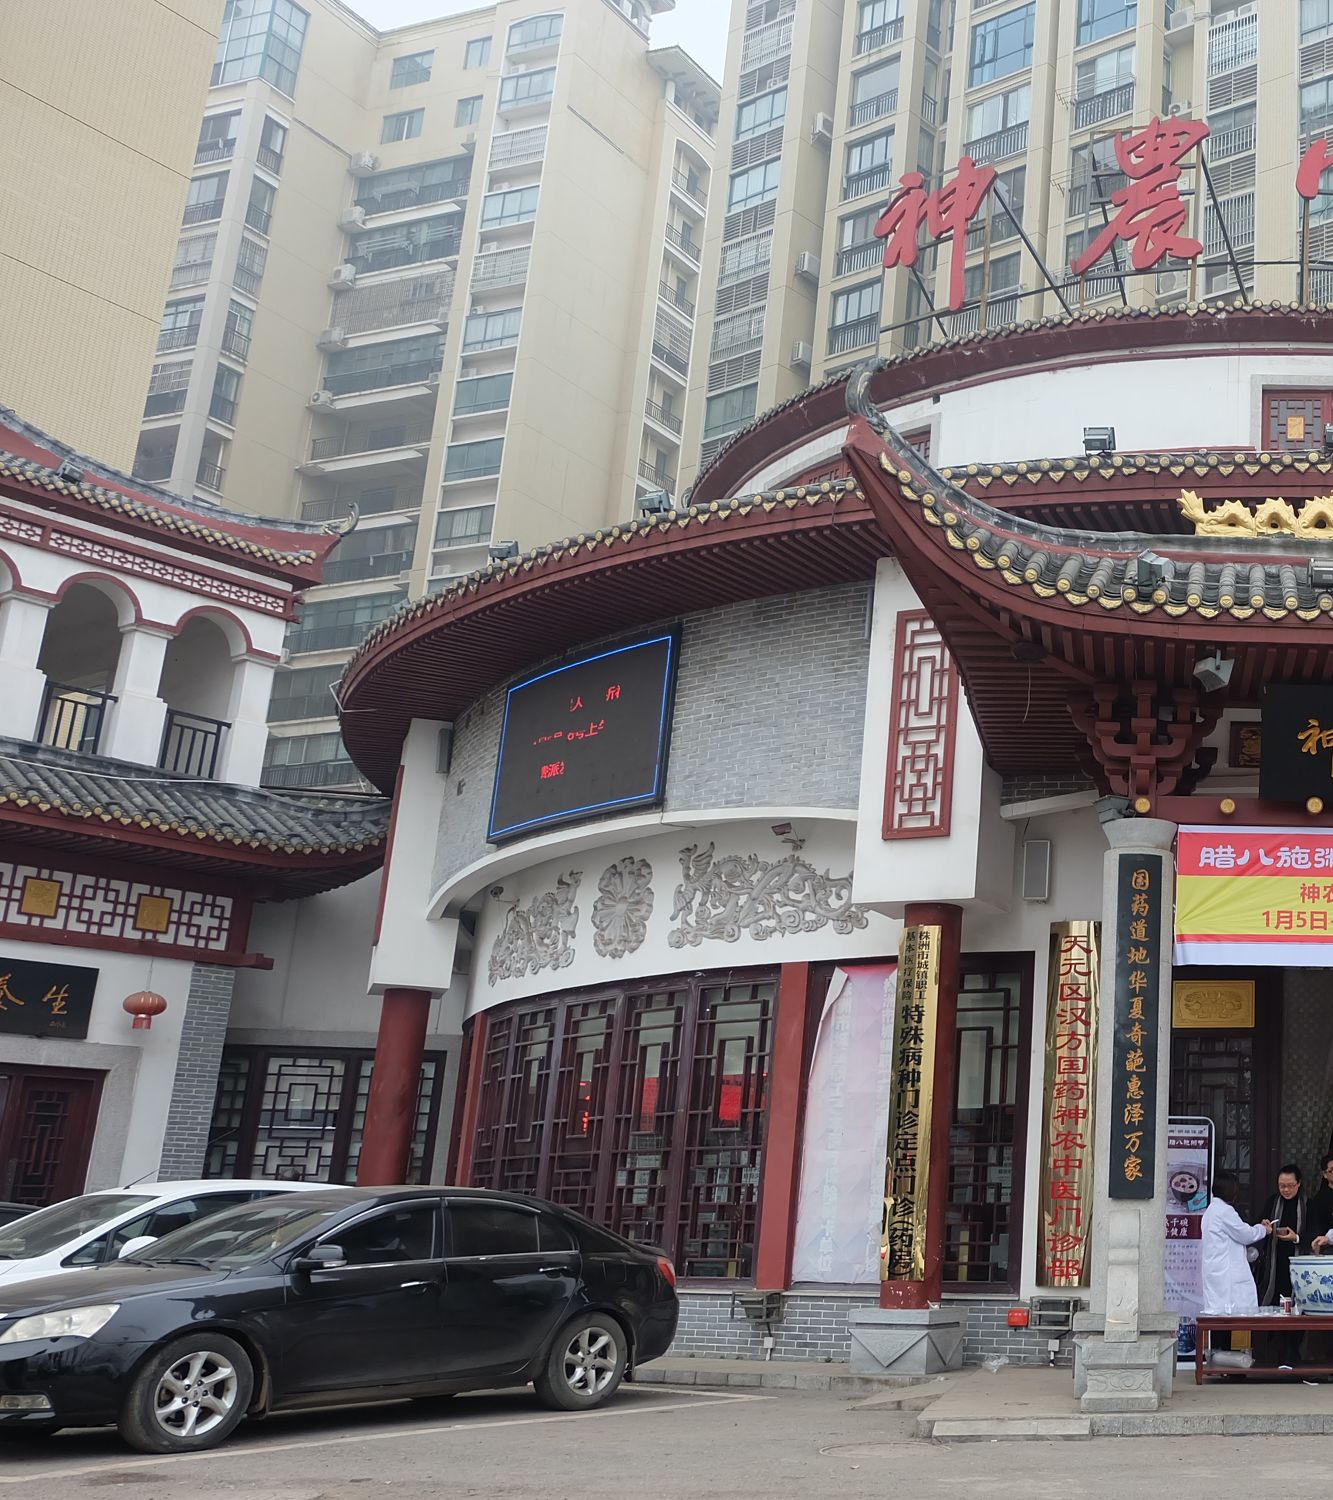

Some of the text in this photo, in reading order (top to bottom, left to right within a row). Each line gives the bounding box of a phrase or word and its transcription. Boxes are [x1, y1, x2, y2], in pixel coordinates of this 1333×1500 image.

[914, 930, 930, 1000] 株洲市城镇职工
[1045, 935, 1093, 1280] 天元区汉方国药神农中医门诊部
[1123, 869, 1150, 1181] 国药道地华夏奇葩惠泽万家
